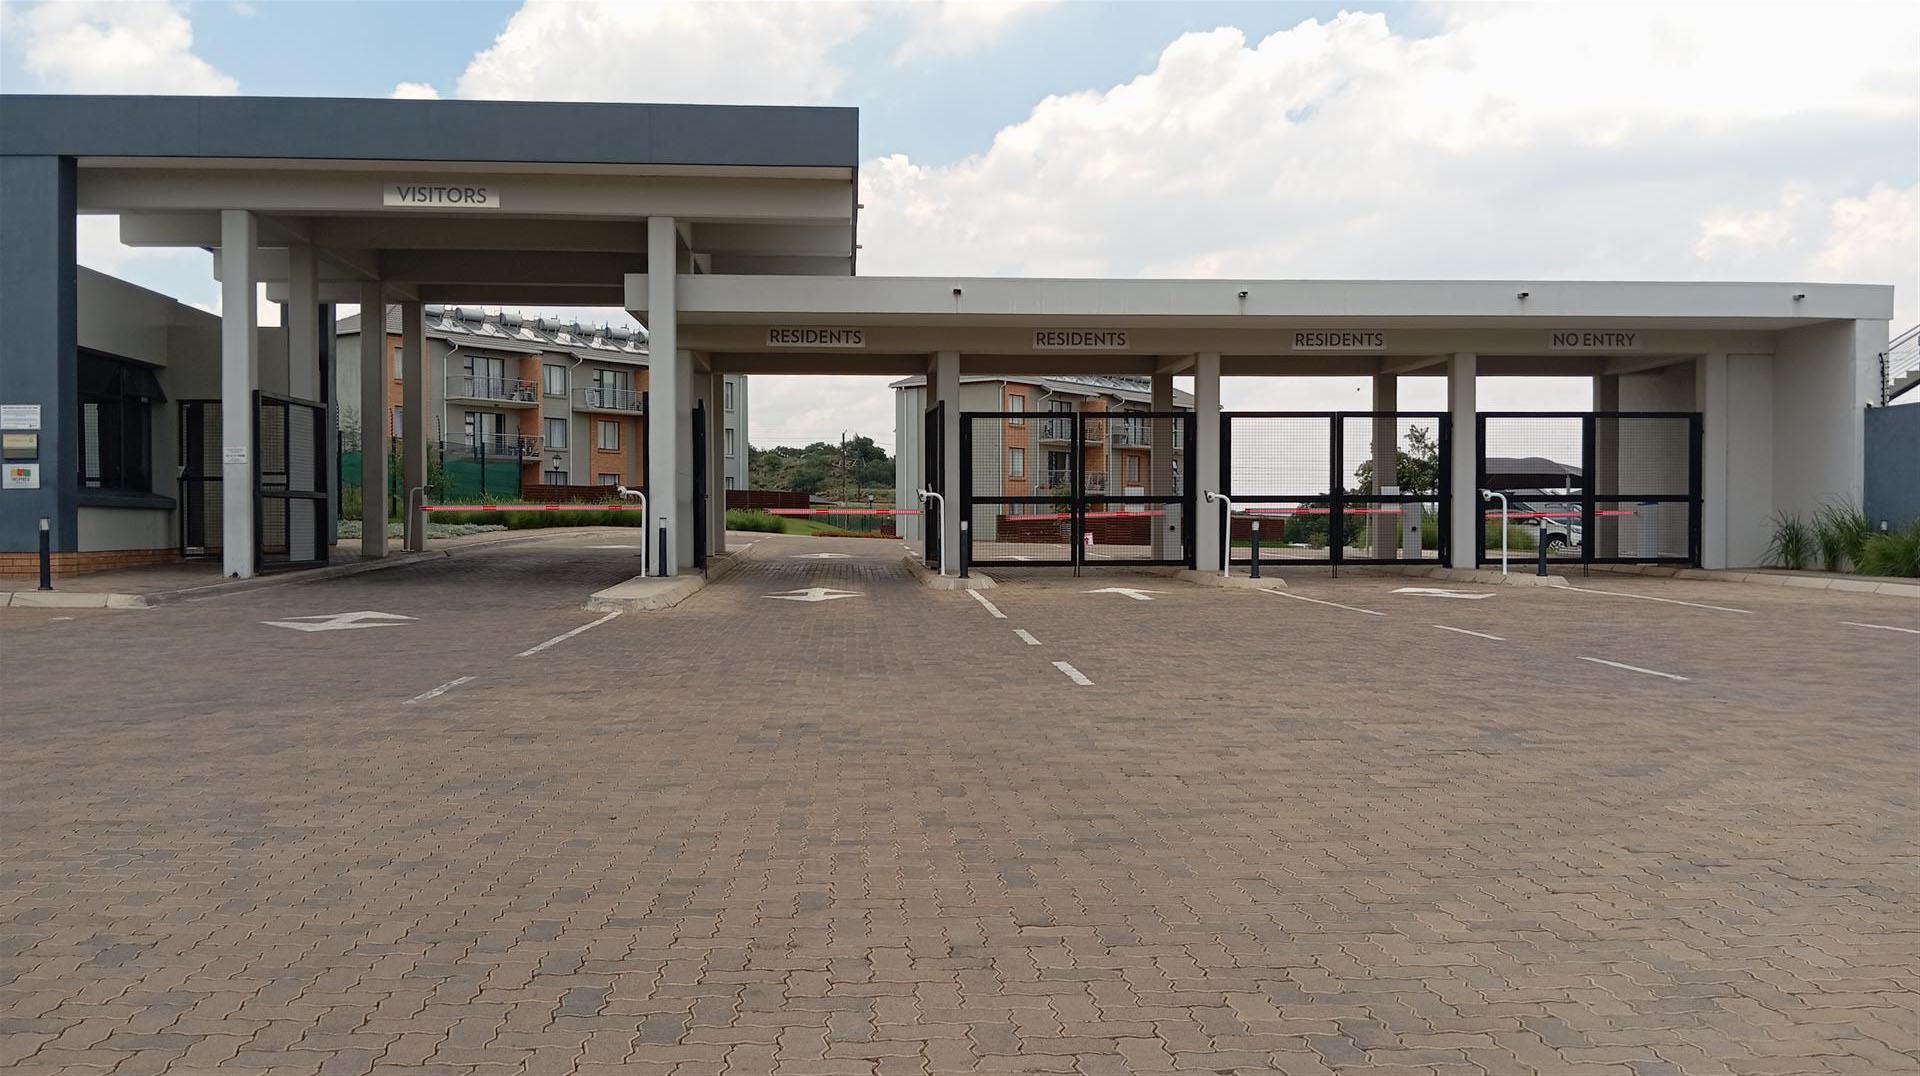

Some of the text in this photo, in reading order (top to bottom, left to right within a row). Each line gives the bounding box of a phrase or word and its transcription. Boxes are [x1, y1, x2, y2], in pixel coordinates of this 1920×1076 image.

[397, 186, 487, 203] VISITORS
[770, 329, 862, 344] RESIDENTS
[1036, 331, 1126, 346] RESIDENTS
[1295, 332, 1383, 346] RESIDENTS
[1553, 332, 1635, 346] NO ENTRY
